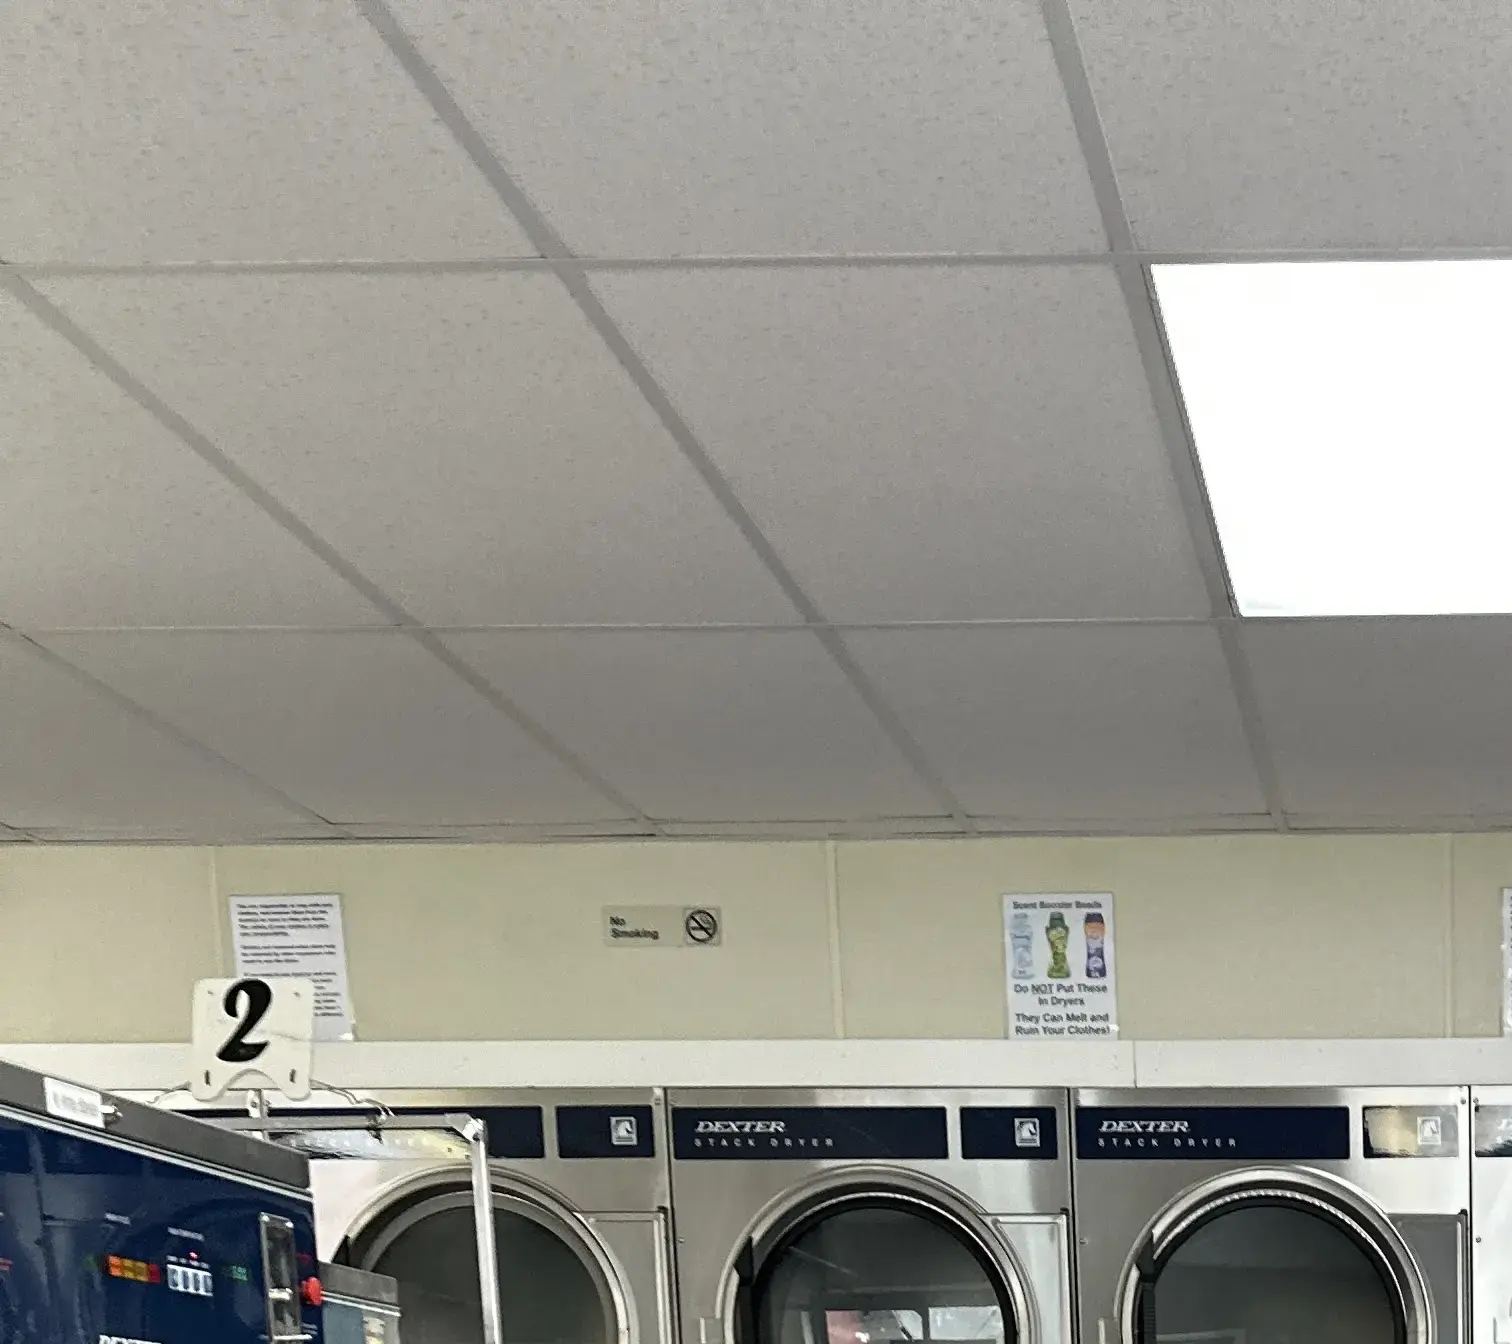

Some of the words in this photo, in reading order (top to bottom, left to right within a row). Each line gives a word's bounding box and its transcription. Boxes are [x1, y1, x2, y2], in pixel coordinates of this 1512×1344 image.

[609, 916, 626, 926] No
[611, 927, 660, 940] Smoking
[216, 979, 272, 1063] 2
[694, 1120, 788, 1133] DEXTER
[1099, 1120, 1191, 1133] DEXTER
[694, 1137, 756, 1147] STACK
[770, 1137, 834, 1147] DRYER
[1098, 1137, 1159, 1148] STACK
[1173, 1137, 1236, 1148] DRYER
